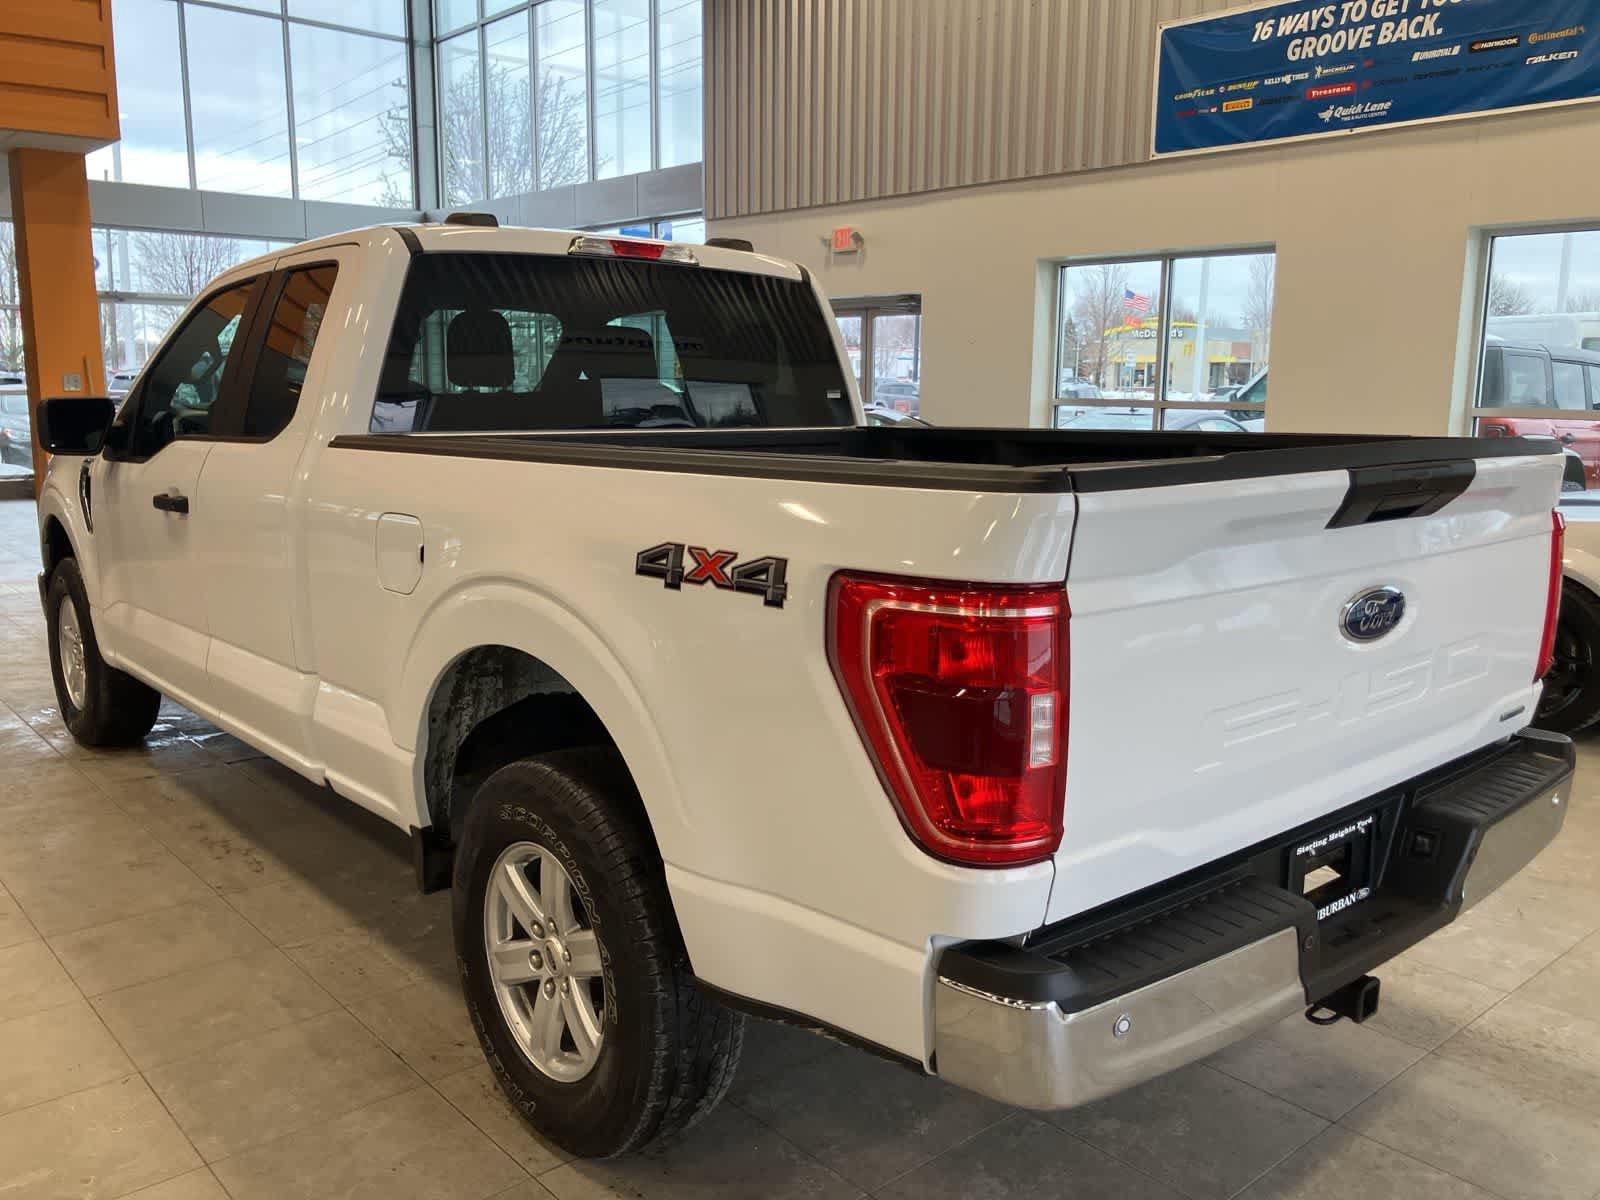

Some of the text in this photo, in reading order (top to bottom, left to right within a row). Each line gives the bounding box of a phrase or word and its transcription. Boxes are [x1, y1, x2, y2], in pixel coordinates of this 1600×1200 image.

[1252, 19, 1275, 42] 16
[1276, 5, 1337, 37] WAYS
[1340, 0, 1367, 25] TO
[1286, 12, 1443, 61] GROOVE BACK.
[1528, 27, 1577, 45] Continental
[1525, 50, 1579, 65] FALKEN
[1174, 88, 1215, 101] GOODYEAR
[1311, 85, 1352, 97] Firestone
[1333, 101, 1392, 119] Quick Lane
[1359, 599, 1396, 632] Ford
[1296, 838, 1328, 855] Sterling
[1316, 891, 1358, 921] BURBAN
